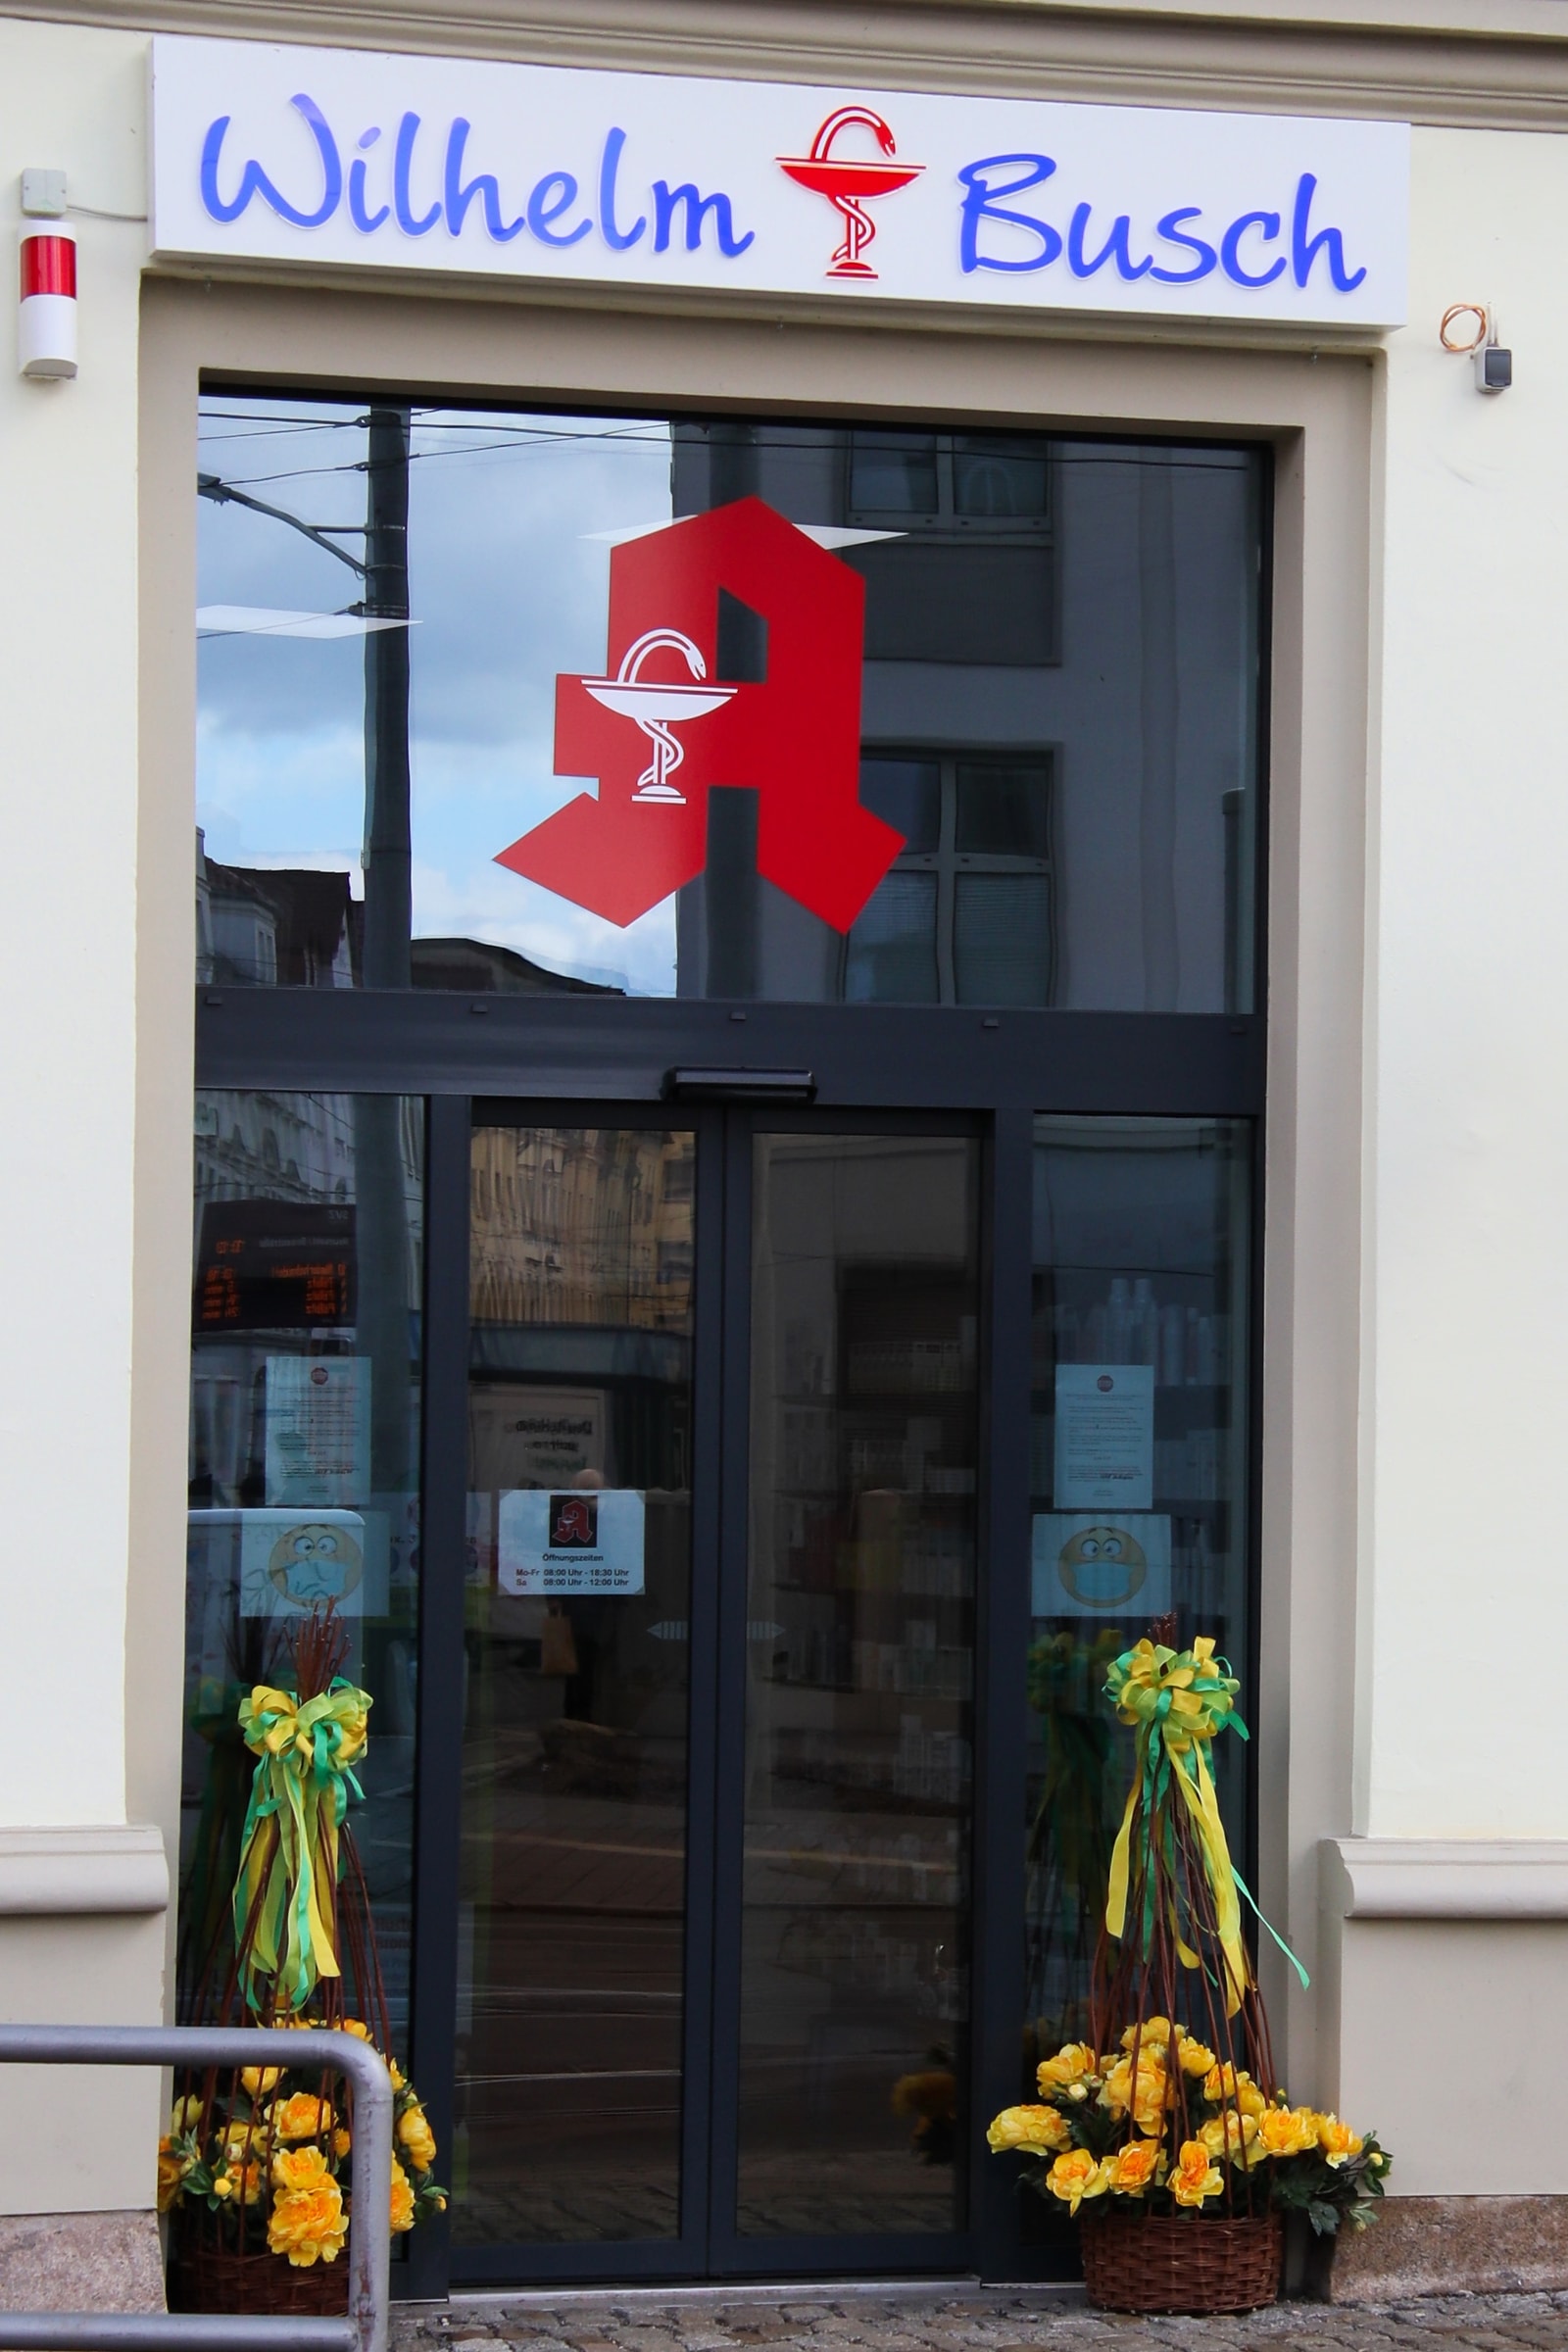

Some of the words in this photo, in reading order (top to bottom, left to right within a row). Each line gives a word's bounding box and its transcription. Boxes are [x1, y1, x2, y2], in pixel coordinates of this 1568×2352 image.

[198, 93, 757, 260] Wilhelm
[956, 152, 1368, 294] Busch
[542, 1552, 604, 1563] Öffnungszeiten
[544, 1568, 566, 1577] 08:00
[567, 1568, 583, 1577] Uhr
[590, 1568, 612, 1577] 18:30
[613, 1568, 629, 1577] Uhr
[516, 1578, 527, 1587] Sa
[544, 1578, 566, 1587] 08:00
[567, 1578, 583, 1587] Uhr
[590, 1578, 612, 1587] 12:00
[613, 1578, 629, 1587] Uhr
